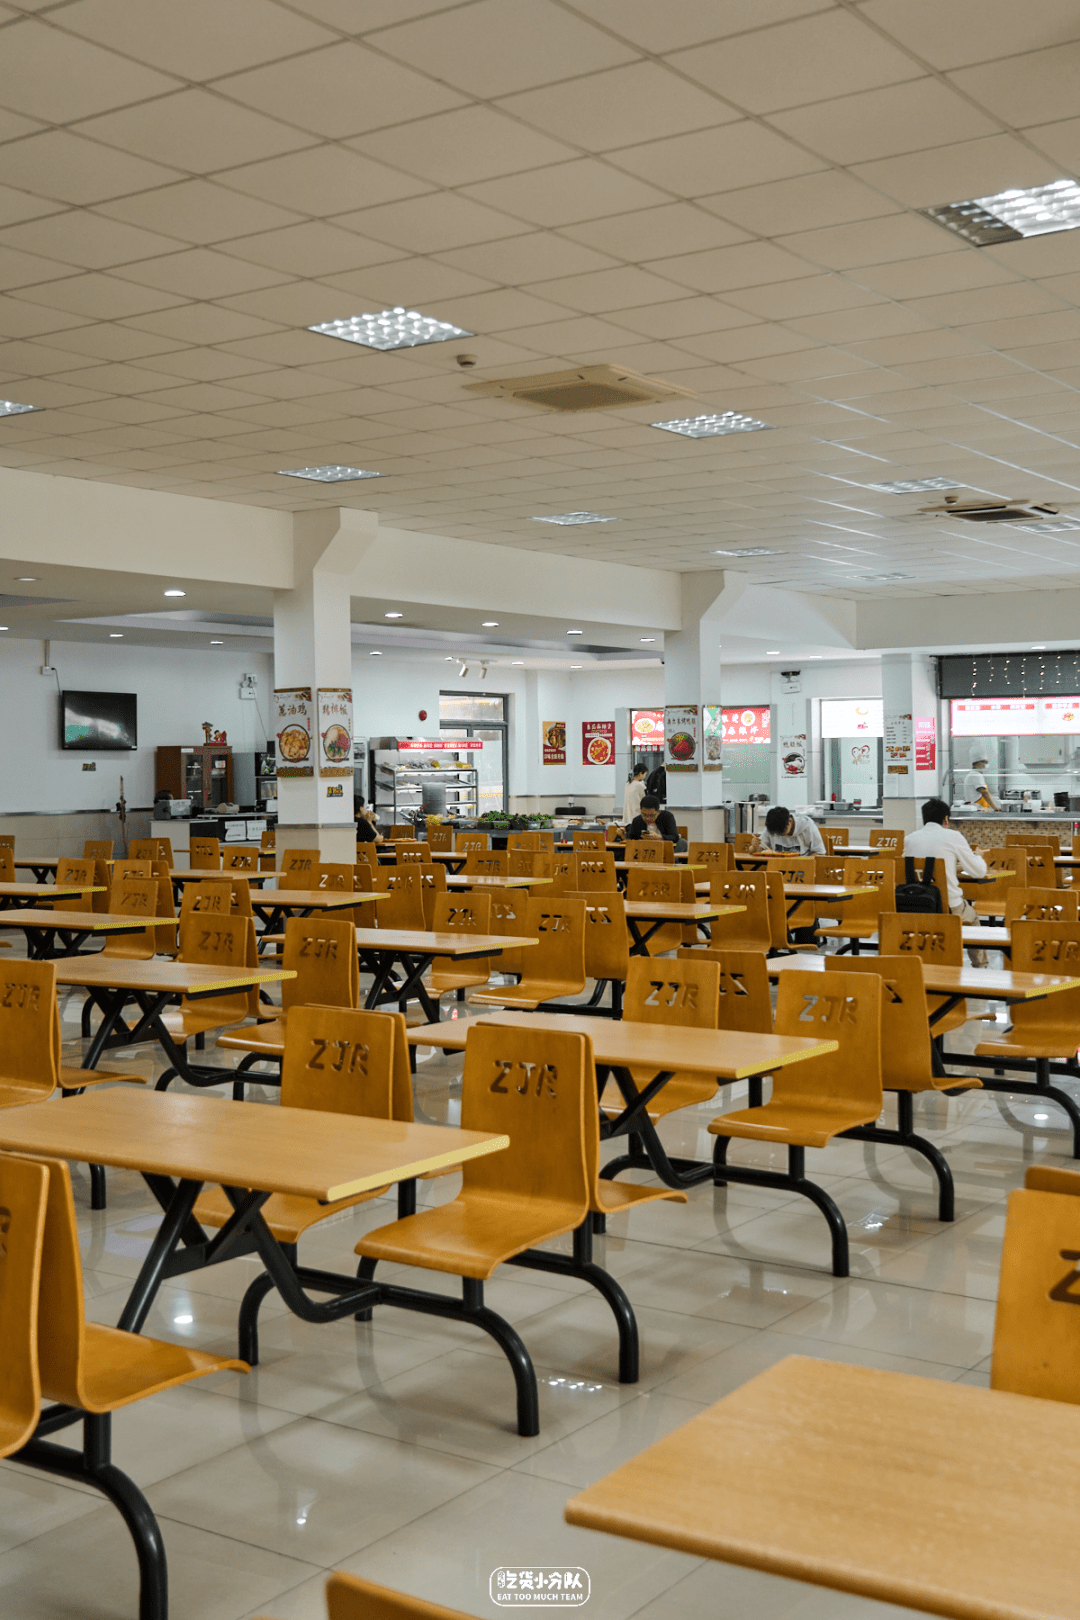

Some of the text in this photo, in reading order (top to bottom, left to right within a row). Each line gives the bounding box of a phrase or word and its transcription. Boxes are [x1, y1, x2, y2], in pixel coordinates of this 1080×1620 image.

[877, 837, 898, 847] ZJR
[231, 856, 252, 868] ZJR
[289, 859, 311, 871] ZJR
[697, 851, 719, 862] ZJR
[65, 868, 87, 882] ZJR
[319, 874, 344, 888] ZJR
[854, 870, 884, 885] ZJR
[193, 896, 221, 912] ZJR
[448, 908, 478, 926] ZJR
[539, 914, 571, 933] ZJR
[199, 931, 234, 952] ZJR
[300, 937, 338, 960] ZJR
[900, 931, 946, 951] ZJR
[2, 982, 41, 1011] ZJR
[645, 981, 699, 1009] ZJR
[799, 995, 859, 1024] ZJR
[306, 1038, 370, 1075] ZJR
[490, 1060, 558, 1098] ZJR
